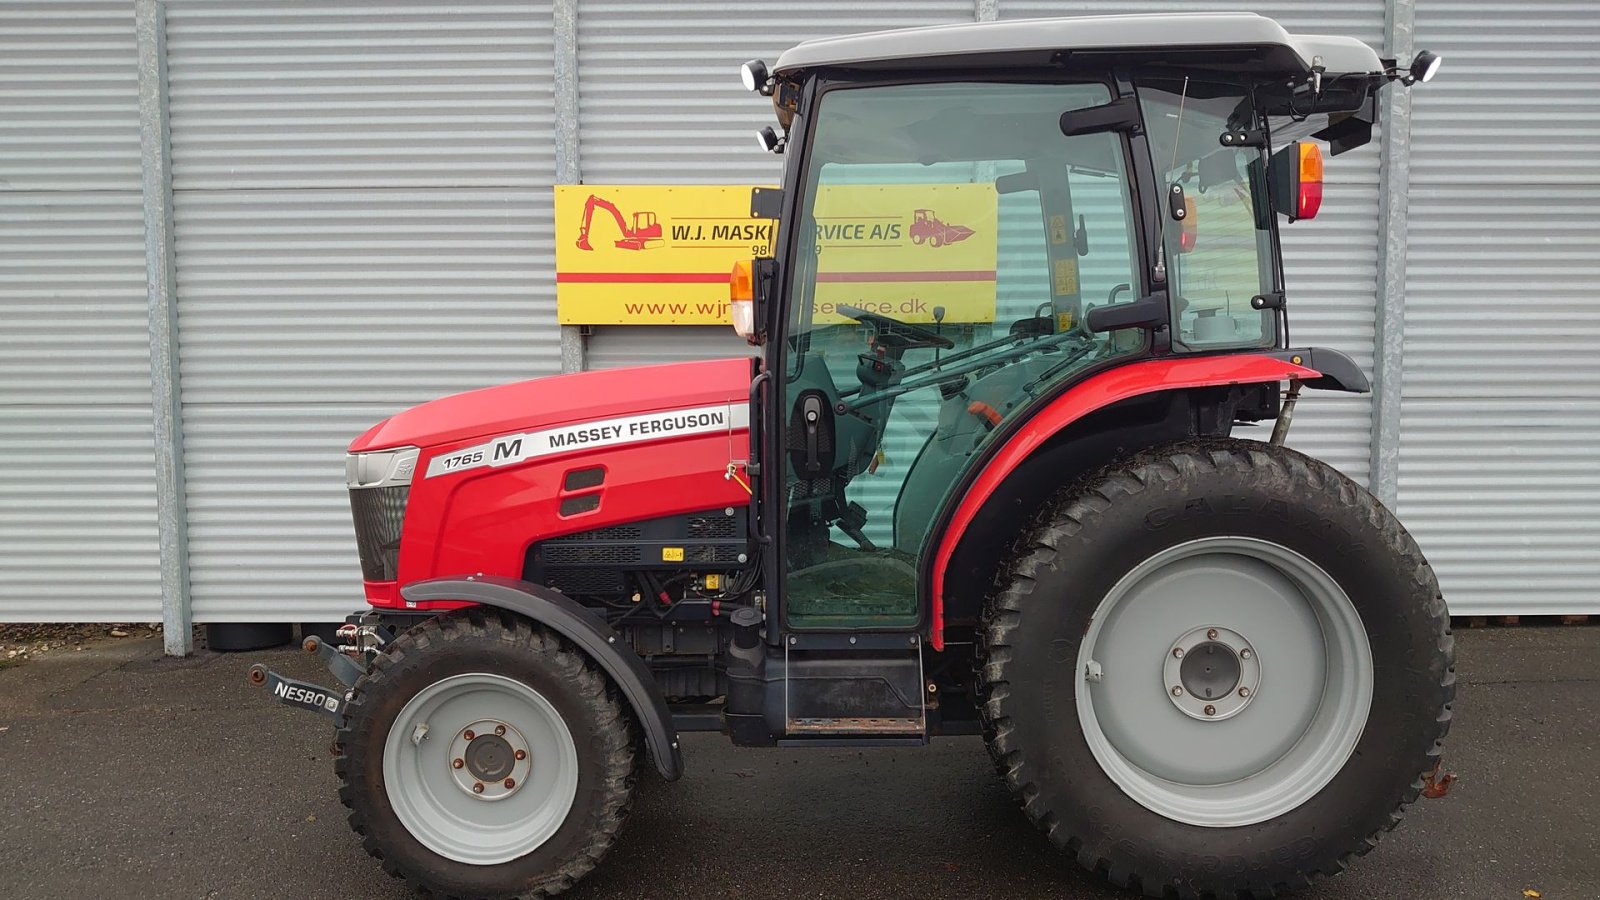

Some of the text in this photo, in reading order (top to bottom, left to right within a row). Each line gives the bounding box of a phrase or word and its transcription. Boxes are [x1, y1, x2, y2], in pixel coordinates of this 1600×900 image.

[671, 225, 706, 241] W.J.
[869, 223, 902, 240] A/S
[442, 412, 724, 469] 1765 M MASSEY FERGUSON
[274, 682, 325, 706] NESBO
